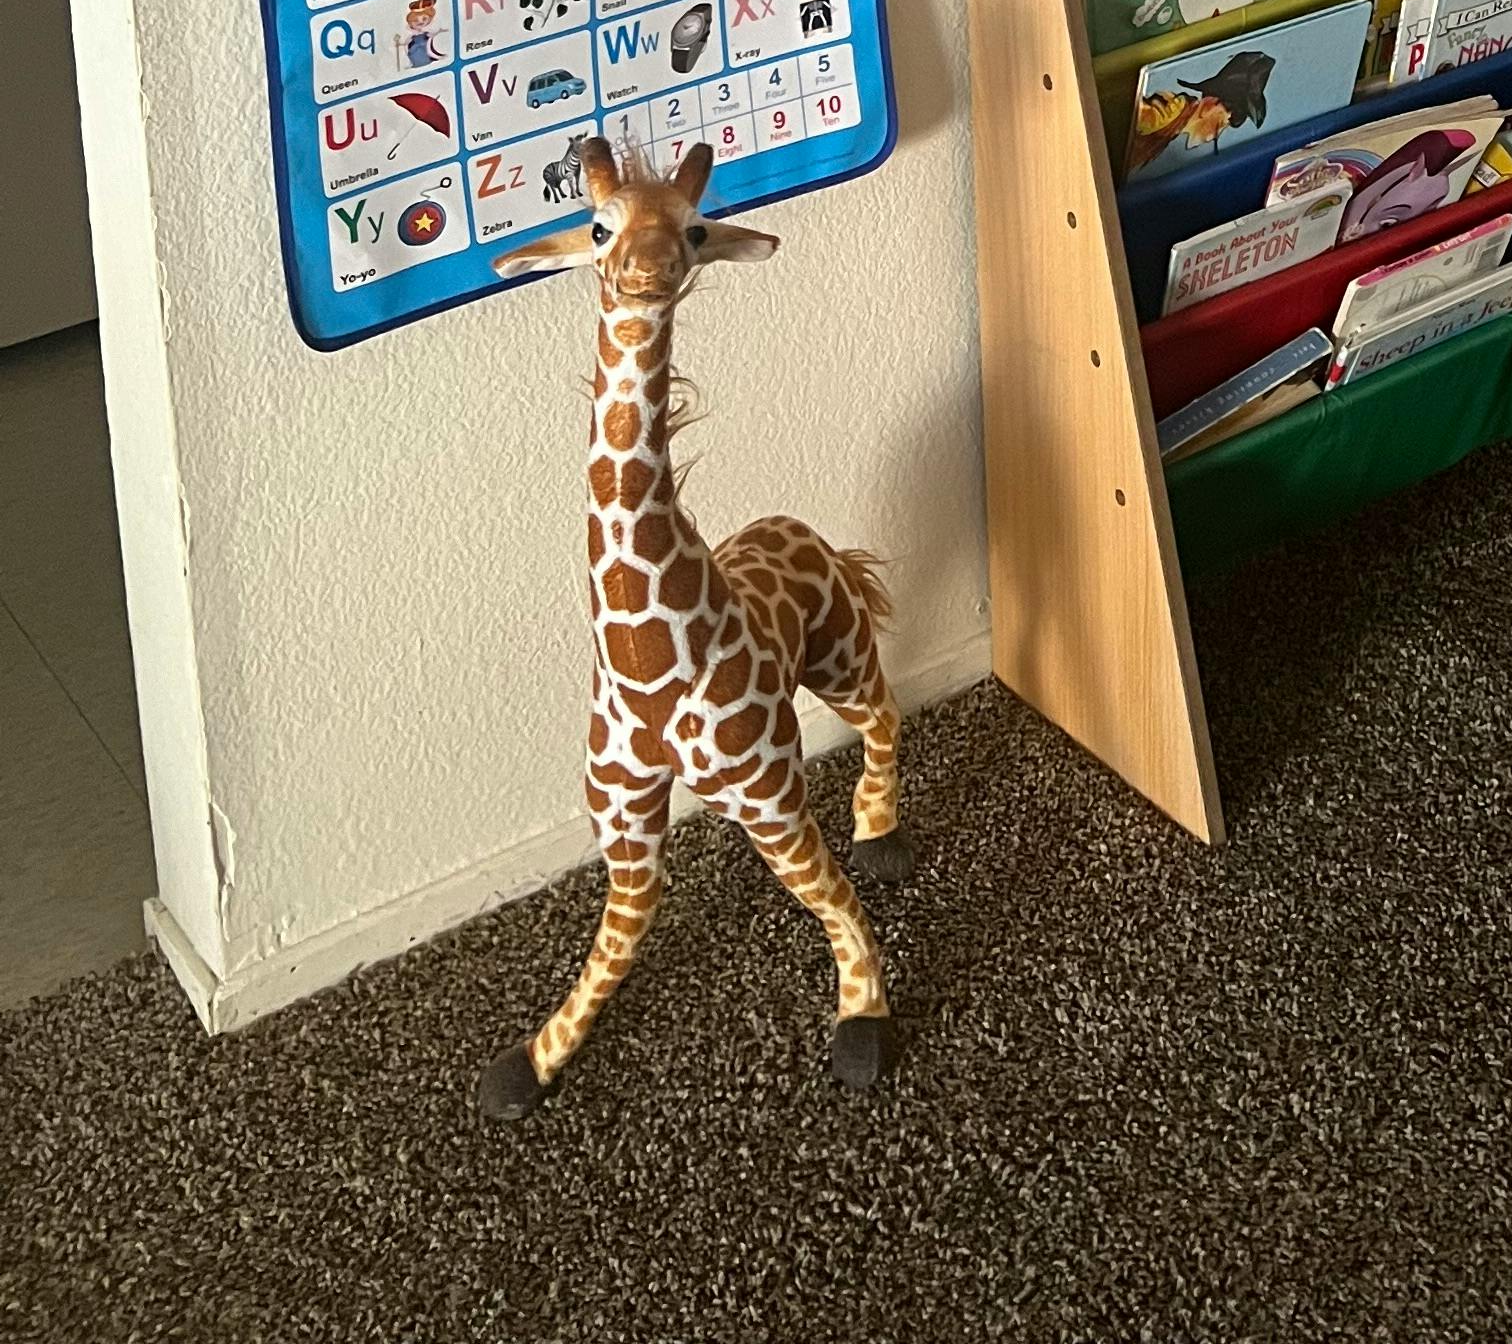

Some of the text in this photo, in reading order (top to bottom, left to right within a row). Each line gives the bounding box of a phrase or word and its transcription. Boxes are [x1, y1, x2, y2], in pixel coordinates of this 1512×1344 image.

[1465, 7, 1488, 23] Can
[466, 38, 493, 52] Rose
[735, 47, 761, 62] X-ray
[818, 54, 831, 73] 5
[1408, 44, 1425, 76] P
[321, 77, 359, 95] Queen
[768, 67, 782, 86] 4
[607, 84, 639, 101] Watch
[718, 83, 731, 102] 3
[668, 98, 680, 118] 2
[816, 95, 842, 117] 10
[773, 111, 786, 130] 9
[472, 130, 493, 143] Van
[722, 126, 735, 144] 8
[671, 140, 684, 160] 7
[330, 166, 379, 190] Umbrella
[482, 218, 513, 236] Zebra
[1183, 216, 1299, 268] A Book About Your
[1176, 227, 1299, 301] SKELETON
[340, 267, 377, 286] Yo-yo
[1433, 319, 1454, 339] in
